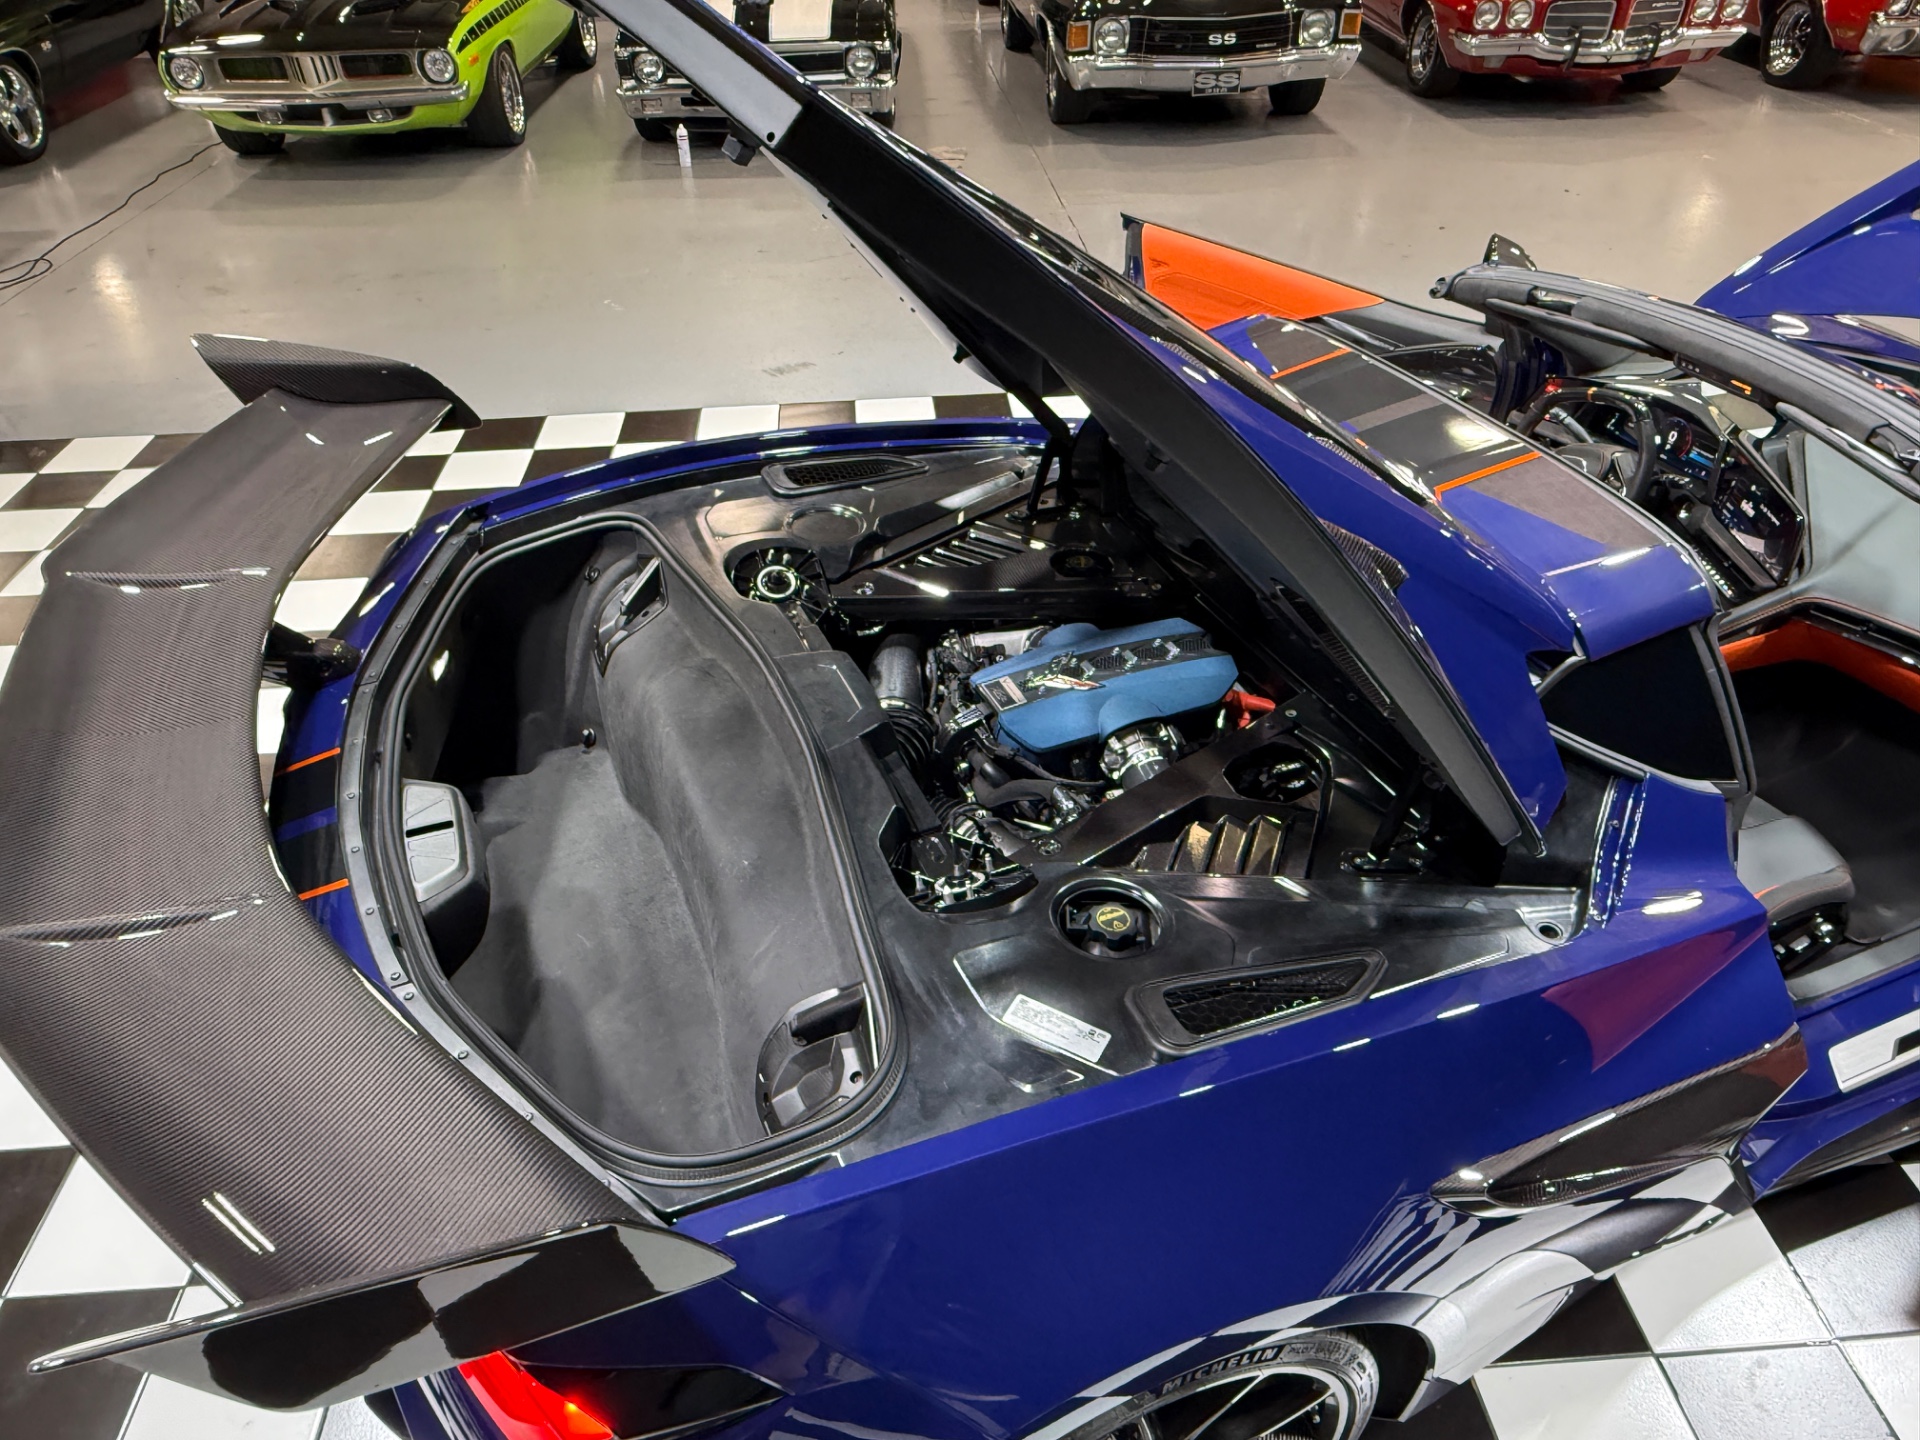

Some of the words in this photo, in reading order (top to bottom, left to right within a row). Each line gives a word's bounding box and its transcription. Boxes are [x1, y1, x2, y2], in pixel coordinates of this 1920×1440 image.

[1208, 32, 1237, 46] SS
[1194, 72, 1240, 89] SS
[1161, 1346, 1279, 1396] MICHELIN
